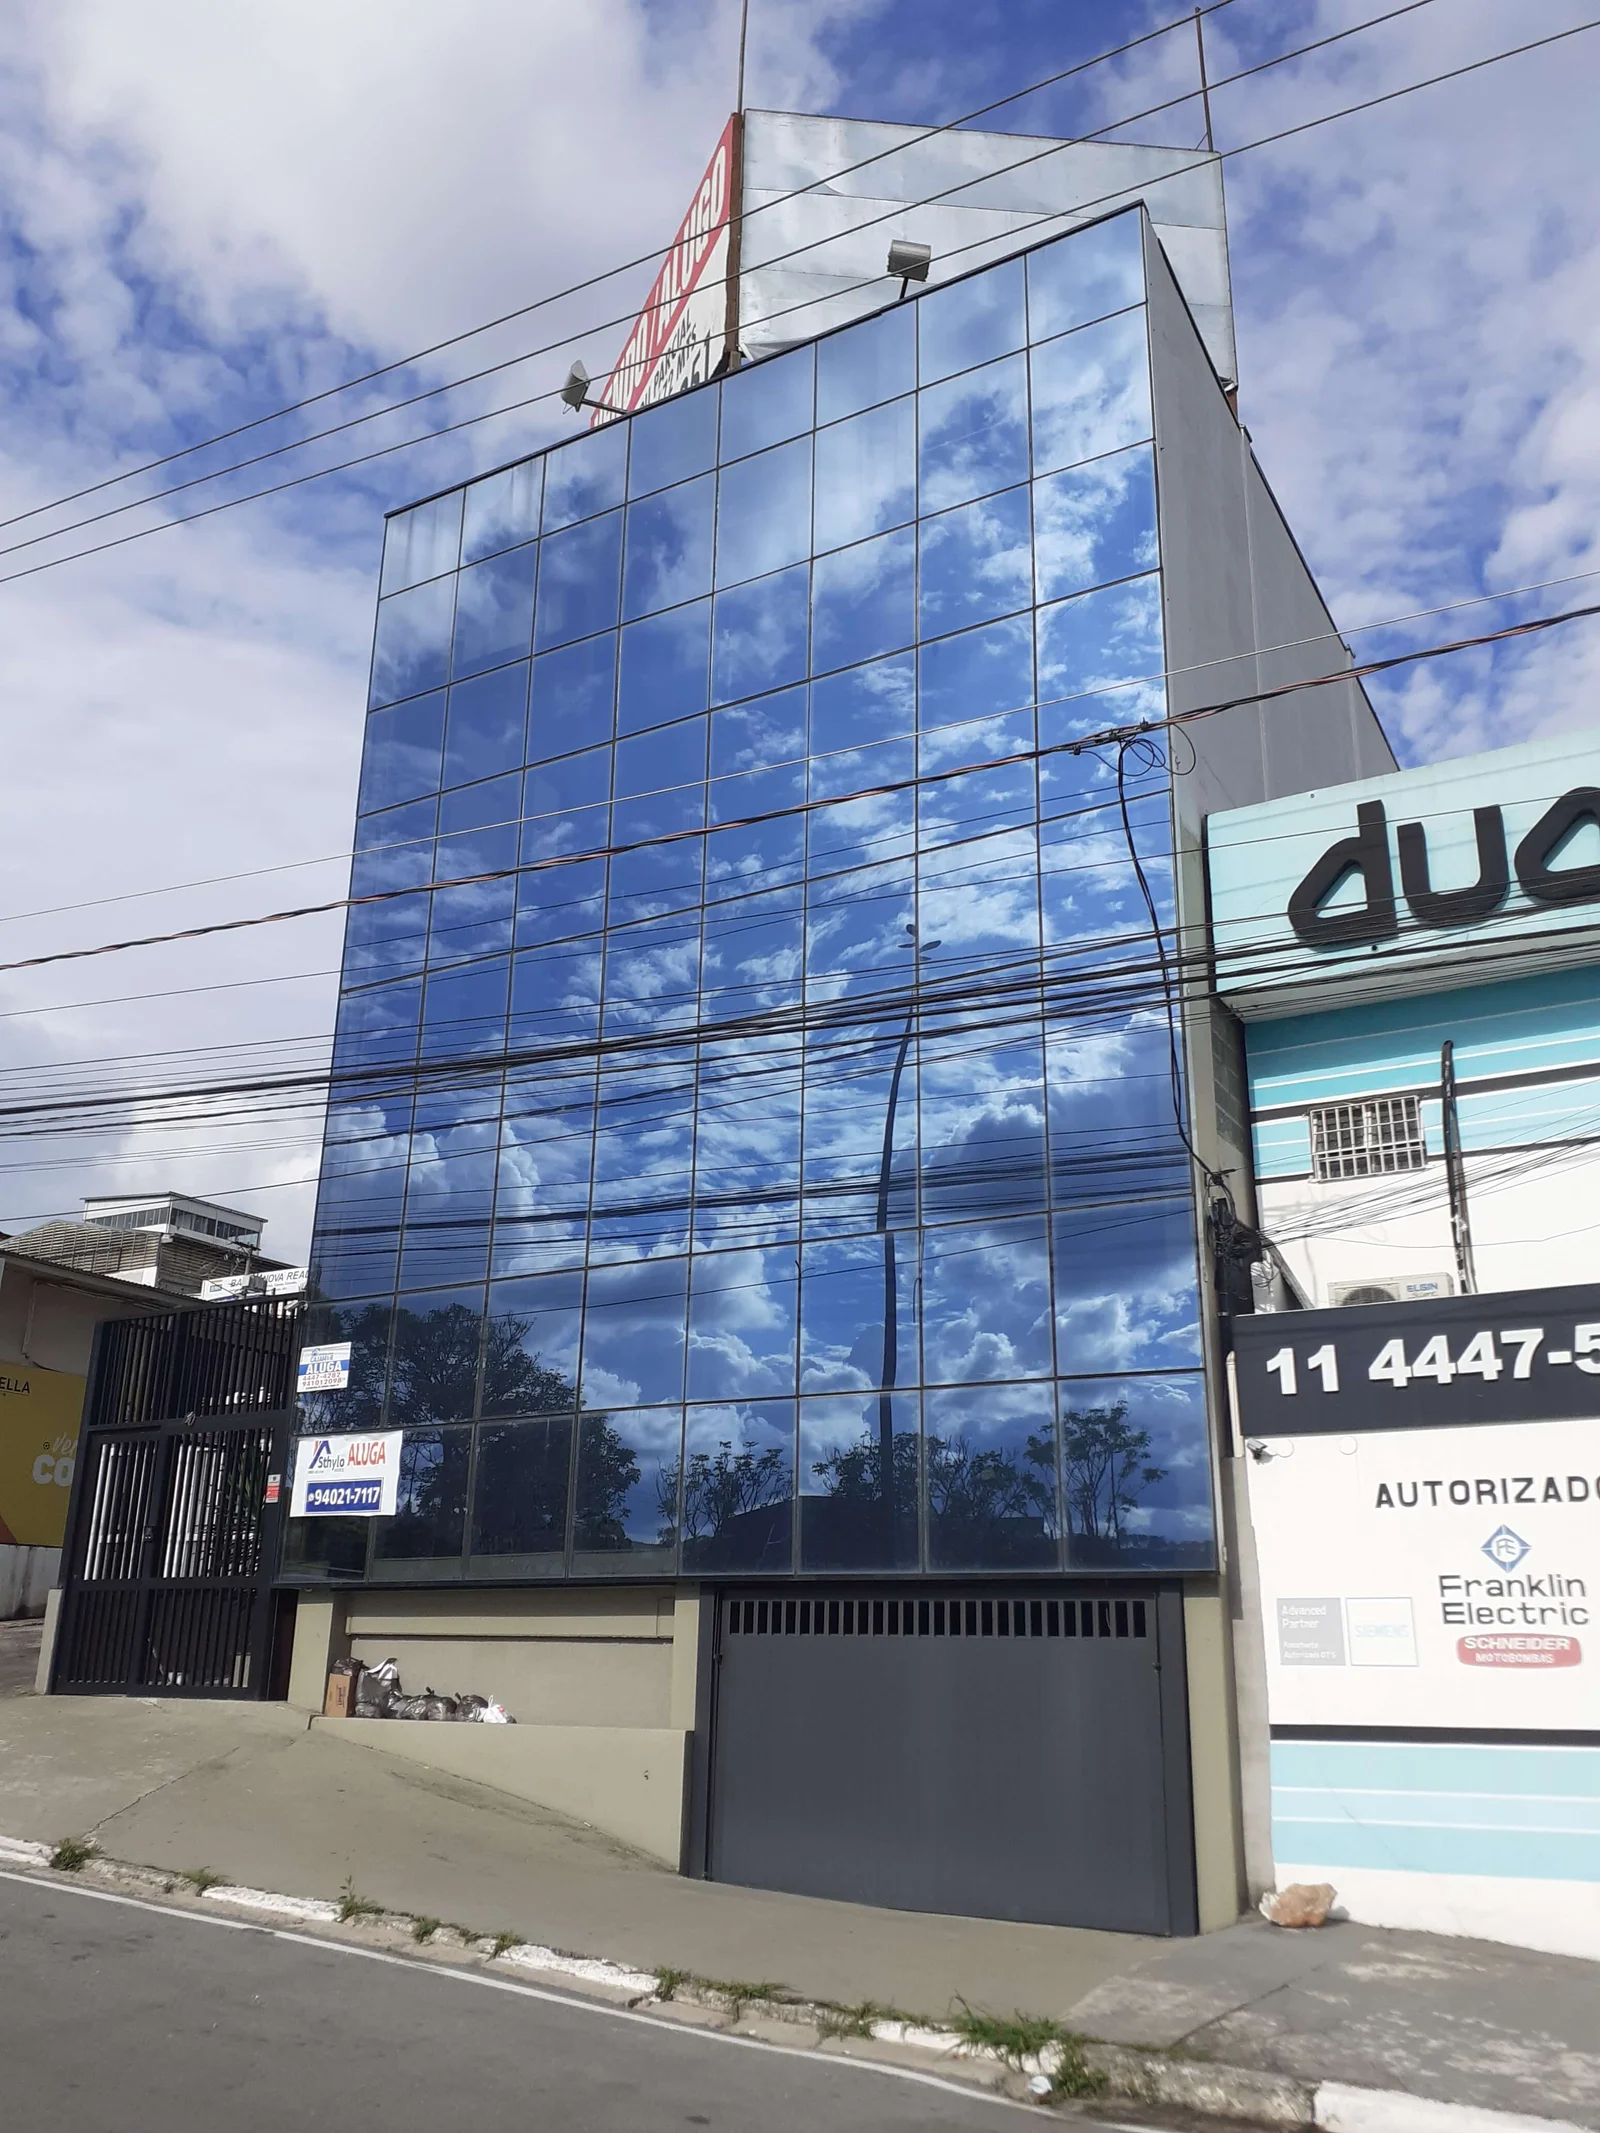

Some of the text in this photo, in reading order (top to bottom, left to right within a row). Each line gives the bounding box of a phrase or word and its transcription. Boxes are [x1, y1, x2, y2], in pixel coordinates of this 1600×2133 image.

[1406, 1282, 1438, 1293] ELGIN
[306, 1360, 342, 1374] ALUGA
[1266, 1322, 1600, 1395] 11 4447-5
[347, 1441, 386, 1466] ALUGA
[32, 1454, 75, 1487] CO
[314, 1486, 380, 1506] 94021-7117
[1438, 1573, 1587, 1598] Franklin
[1281, 1604, 1327, 1616] Advanced
[1442, 1602, 1590, 1626] Electric
[1282, 1617, 1320, 1629] Partner
[1464, 1636, 1571, 1650] SCHNEIDER
